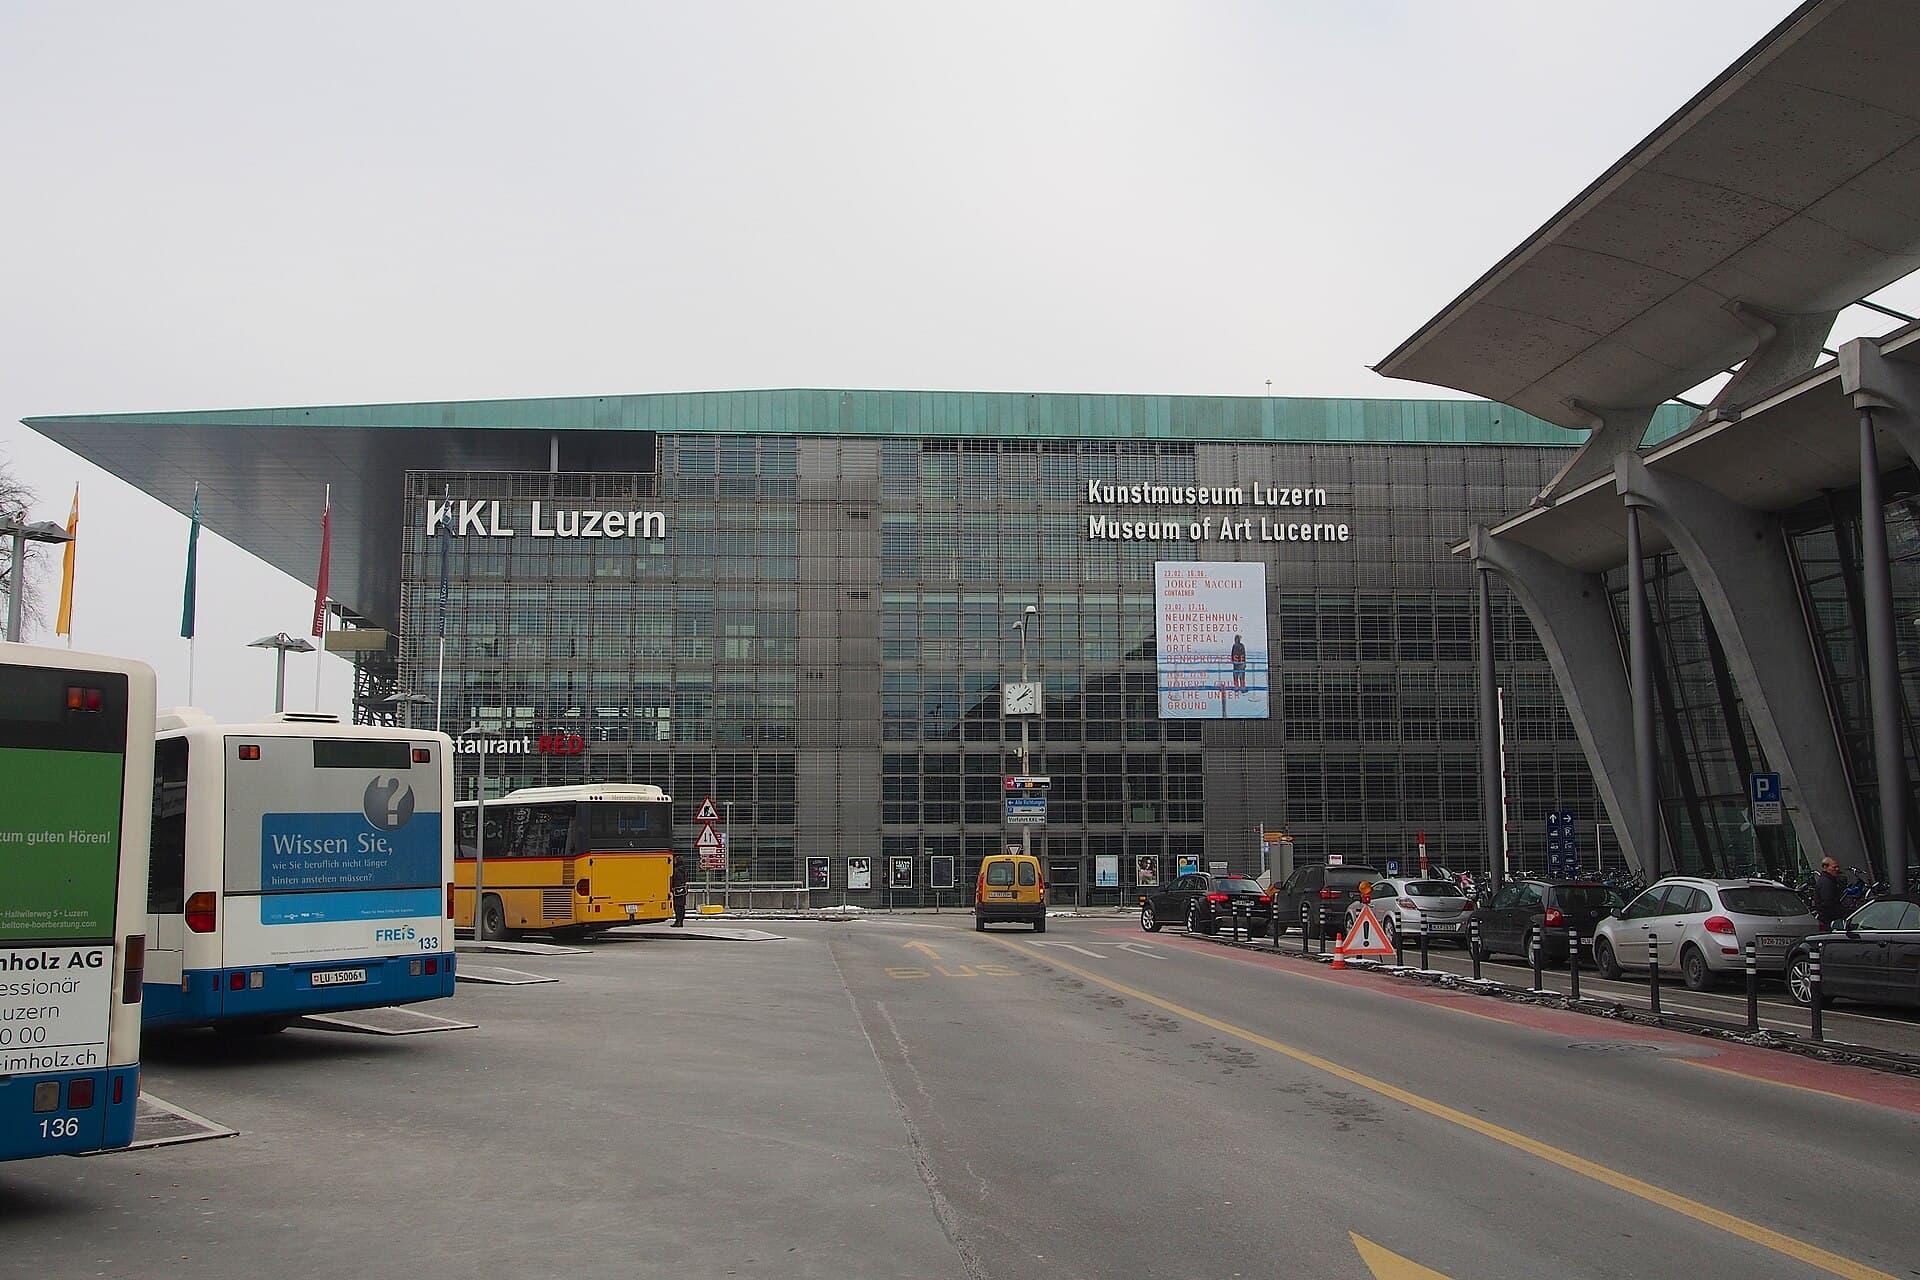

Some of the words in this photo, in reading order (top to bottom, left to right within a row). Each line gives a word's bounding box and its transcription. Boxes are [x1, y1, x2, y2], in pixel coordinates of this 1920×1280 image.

[1088, 480, 1243, 505] Kunstmuseum
[1254, 482, 1327, 506] Luzern
[426, 500, 514, 536] KKL
[531, 501, 666, 538] Luzern
[1089, 515, 1180, 540] Museum
[1190, 517, 1211, 541] of
[1220, 517, 1252, 541] Art
[1261, 517, 1350, 542] Lucerne
[1165, 580, 1197, 588] JORGE
[1205, 580, 1243, 588] MACCHI
[1165, 613, 1244, 622] NEUNZEHNHUN-
[1167, 701, 1207, 710] GROUND
[538, 735, 585, 755] RED
[0, 832, 23, 843] um
[27, 830, 65, 846] guten
[68, 830, 111, 844] Hören!
[271, 834, 348, 855] Wissen
[357, 832, 393, 855] Sie,
[272, 862, 287, 870] wie
[289, 861, 302, 869] Sie
[304, 860, 340, 869] beruflich
[342, 859, 362, 868] nicht
[364, 858, 388, 868] länger
[271, 876, 299, 885] hinten
[301, 875, 337, 884] anstehen
[339, 873, 373, 883] müssen?
[418, 937, 439, 950] 133
[67, 950, 104, 969] AG
[884, 964, 1025, 980] BUS
[0, 1005, 60, 1021] uzern
[19, 1026, 46, 1044] 00
[0, 1049, 97, 1071] imholz.ch
[39, 1117, 79, 1138] 136
